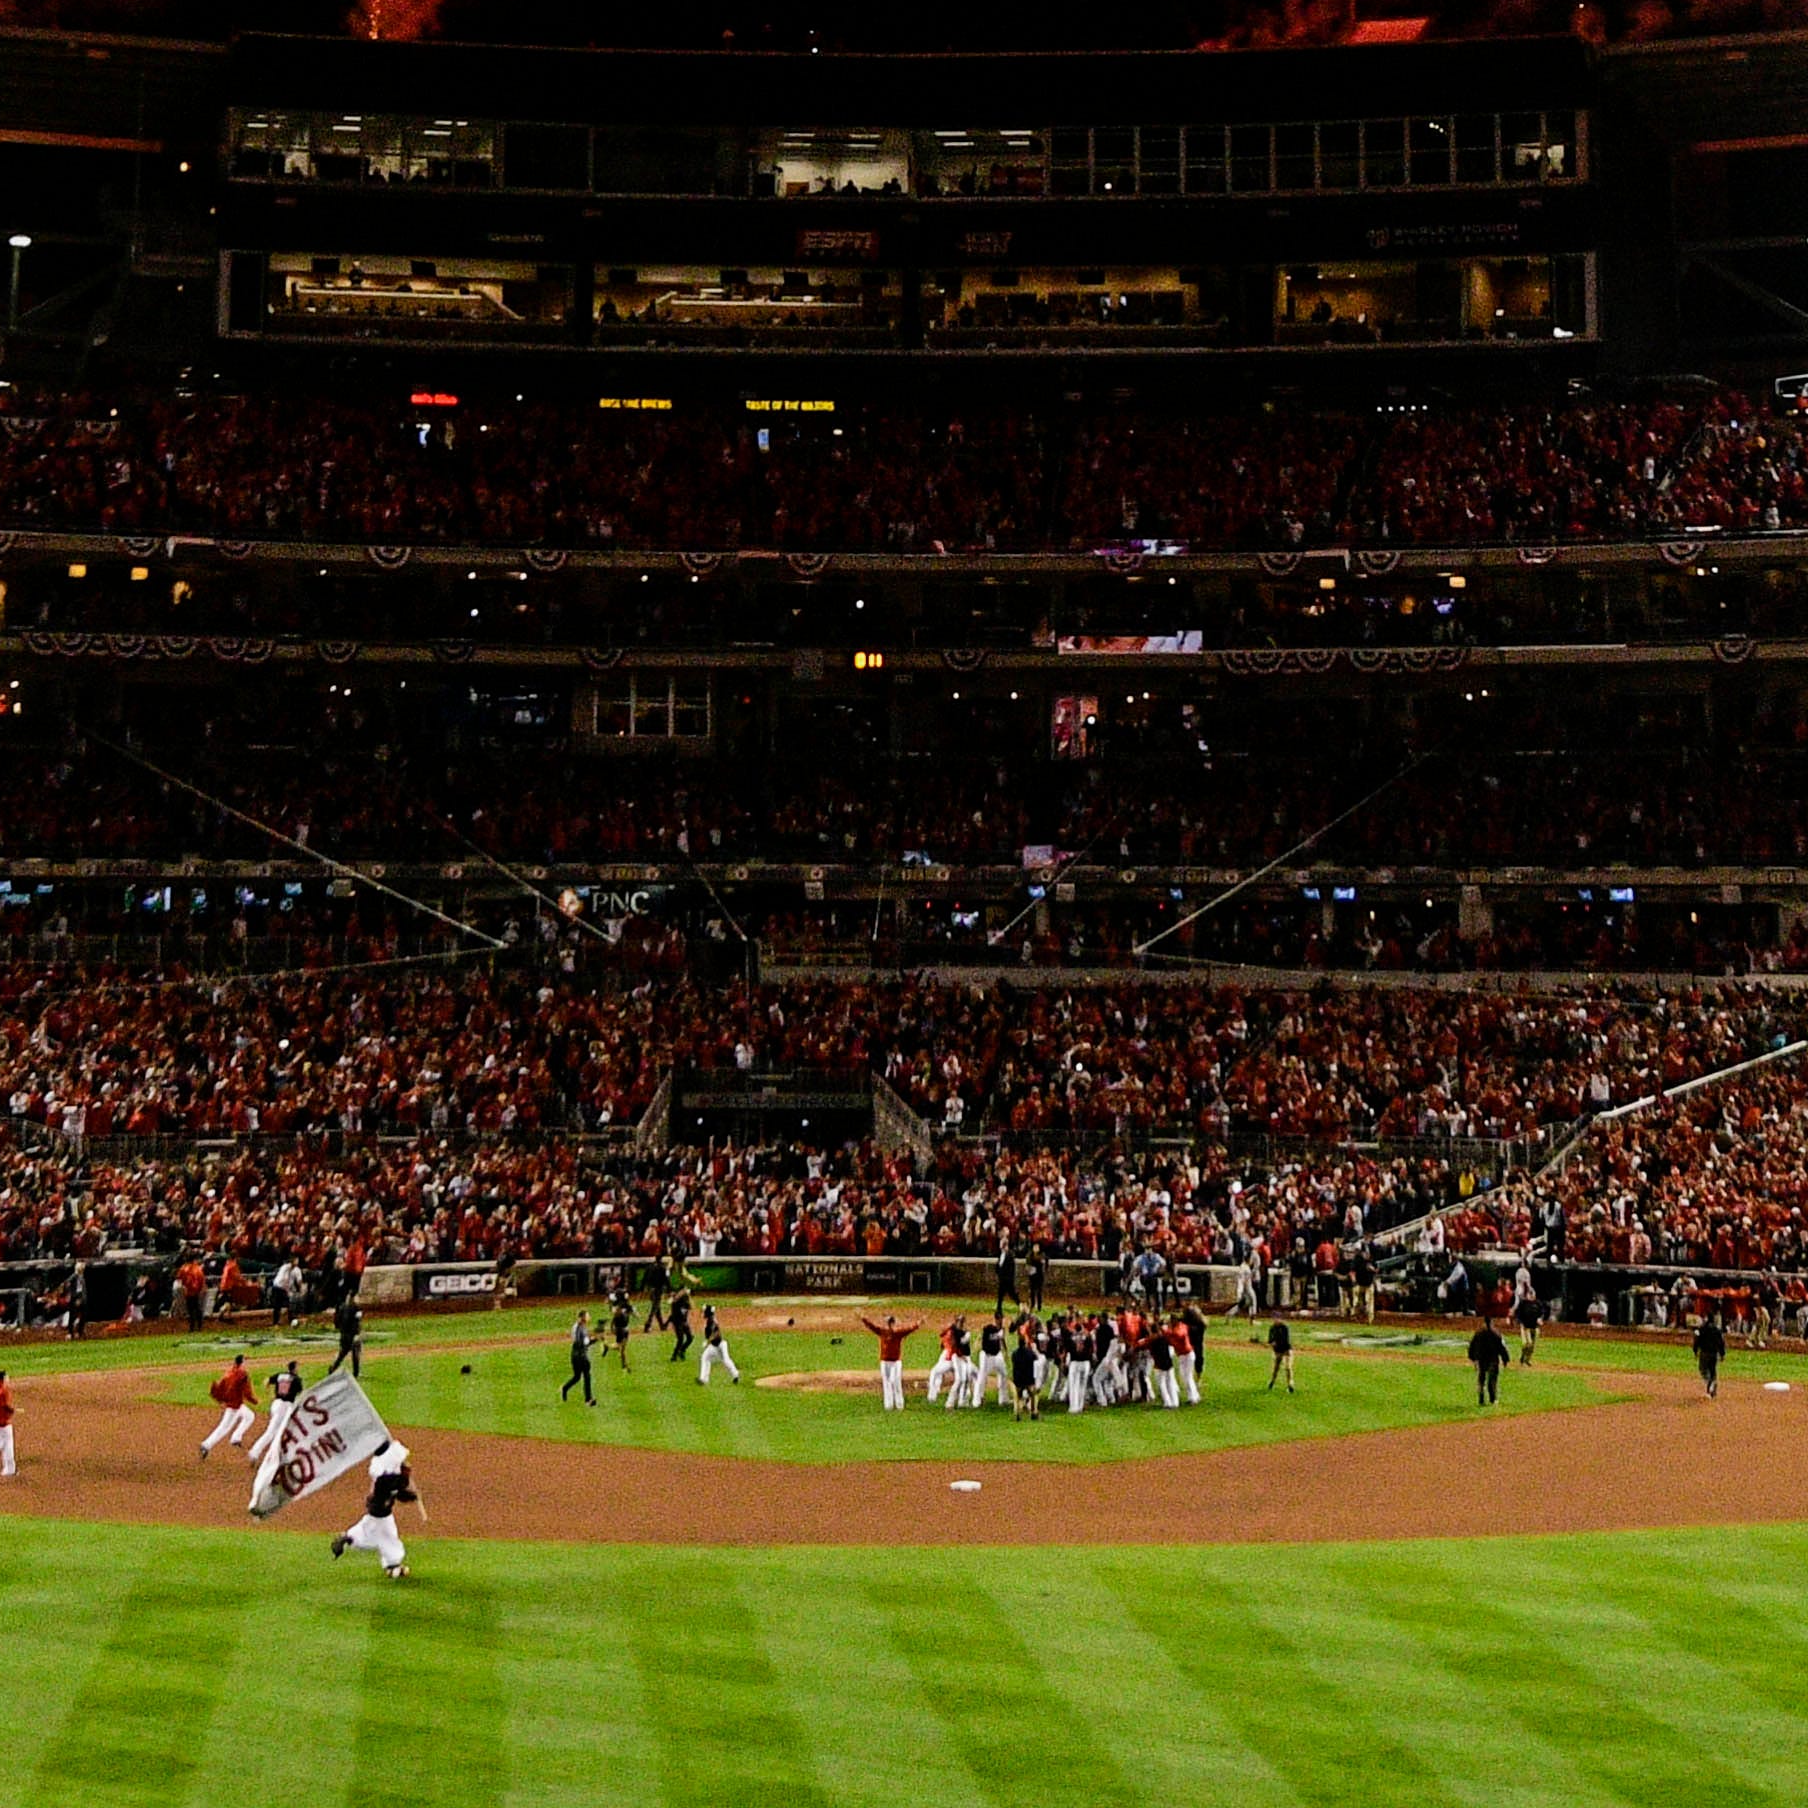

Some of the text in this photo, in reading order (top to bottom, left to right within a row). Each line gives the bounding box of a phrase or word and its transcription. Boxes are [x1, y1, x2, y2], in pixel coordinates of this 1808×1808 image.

[592, 891, 650, 915] PNC
[785, 1263, 864, 1275] NATIONALS
[805, 1275, 843, 1288] PARK
